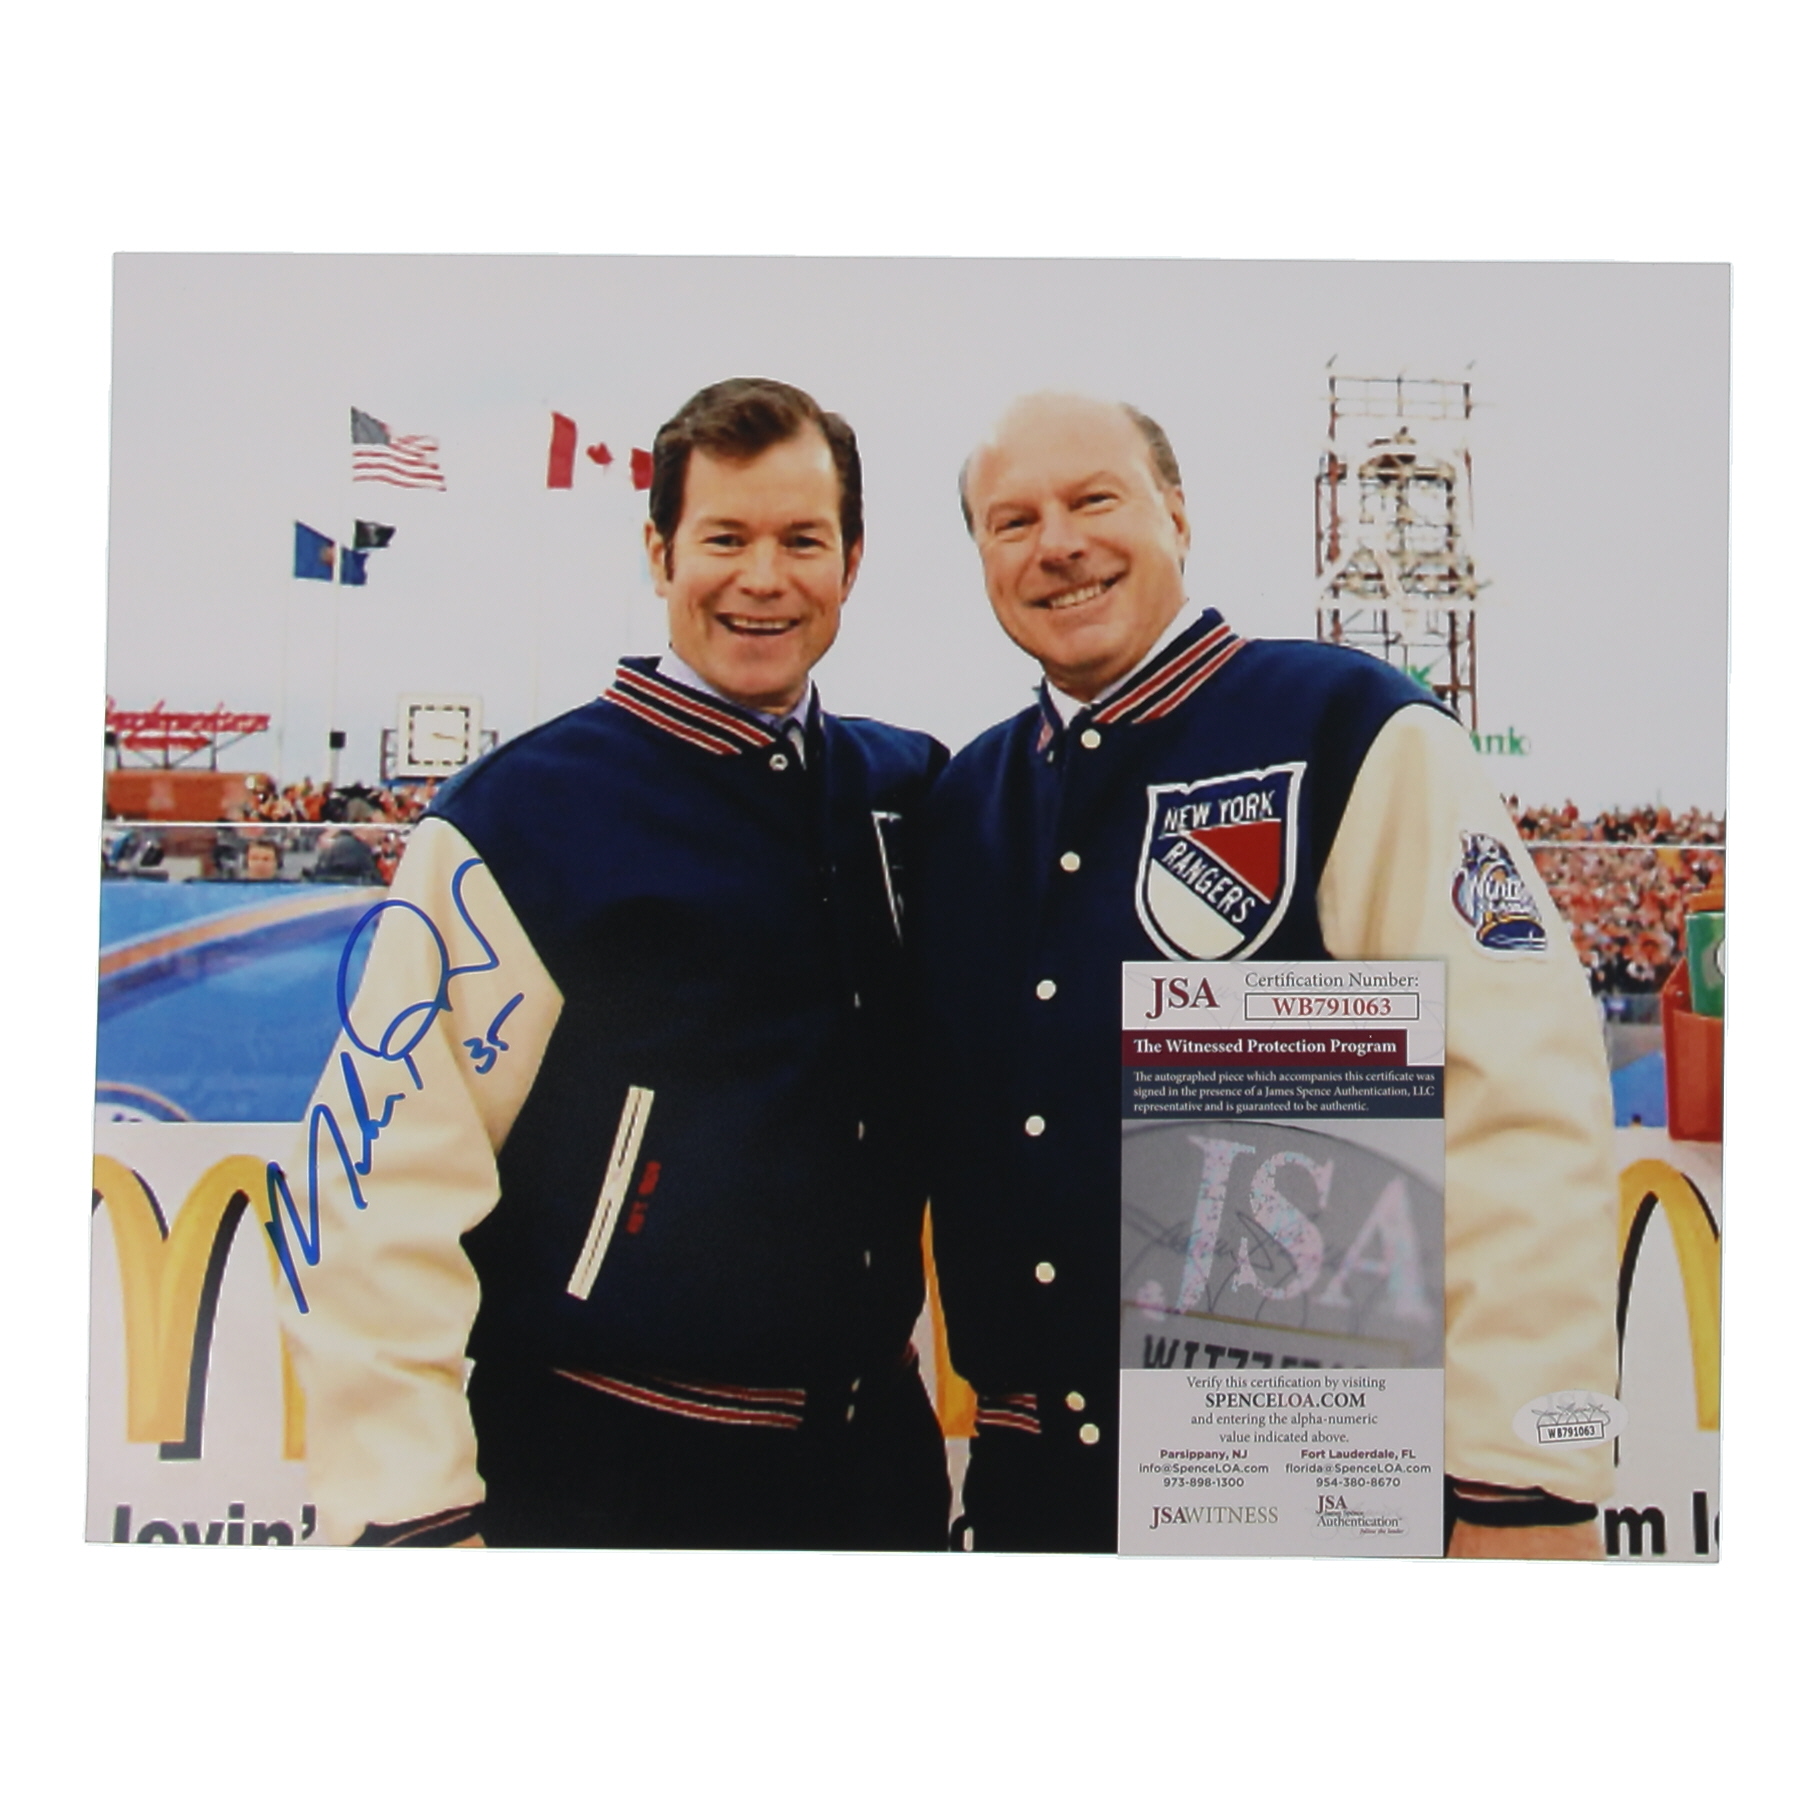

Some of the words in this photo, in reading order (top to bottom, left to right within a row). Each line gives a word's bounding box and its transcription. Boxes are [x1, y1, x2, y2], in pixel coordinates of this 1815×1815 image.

[1164, 801, 1213, 831] NEW
[1218, 789, 1276, 824] YORK
[1161, 840, 1256, 924] RANGERS
[1244, 972, 1344, 988] Certification
[1348, 972, 1419, 988] Number:
[1145, 977, 1221, 1020] JSA
[1271, 996, 1392, 1017] WB791063
[1133, 1038, 1162, 1054] The
[1165, 1038, 1243, 1053] Witnessed
[1247, 1038, 1326, 1053] Protection
[1330, 1039, 1397, 1057] Program
[1133, 1070, 1153, 1082] The
[1154, 1070, 1217, 1084] autographed
[1218, 1071, 1245, 1084] piece
[1246, 1070, 1277, 1082] which
[1278, 1072, 1343, 1084] accompanies
[1344, 1070, 1364, 1082] this
[1365, 1070, 1415, 1082] certificate
[1416, 1073, 1436, 1082] was
[1133, 1085, 1166, 1098] signed
[1168, 1086, 1179, 1097] in
[1180, 1085, 1196, 1097] the
[1199, 1088, 1242, 1099] presence
[1244, 1085, 1255, 1097] of
[1257, 1088, 1263, 1097] a
[1264, 1085, 1295, 1098] James
[1296, 1086, 1332, 1099] Spence
[1334, 1085, 1411, 1098] Authentication,
[1412, 1085, 1435, 1096] LLC
[1133, 1101, 1203, 1114] representative
[1204, 1100, 1224, 1112] and
[1225, 1101, 1235, 1112] is
[1236, 1101, 1291, 1114] guaranteed
[1293, 1102, 1304, 1111] to
[1305, 1100, 1319, 1111] be
[1320, 1100, 1369, 1112] authentic.
[1186, 1376, 1223, 1391] Verify
[1225, 1375, 1248, 1388] this
[1250, 1375, 1322, 1388] certification
[1324, 1375, 1340, 1391] by
[1341, 1376, 1386, 1391] visiting
[1205, 1392, 1366, 1408] SPENCELOA.COM
[1190, 1411, 1214, 1425] and
[1216, 1413, 1266, 1428] entering
[1268, 1411, 1288, 1425] the
[1290, 1411, 1378, 1428] alpha-numeric
[1219, 1430, 1251, 1443] value
[1253, 1430, 1308, 1443] indicated
[1311, 1430, 1349, 1443] above.
[1547, 1425, 1596, 1439] WB791063
[1160, 1449, 1230, 1461] Parsippany,
[1231, 1449, 1248, 1460] NJ
[1300, 1449, 1326, 1460] Fort
[1328, 1449, 1399, 1461] Lauderdale,
[1401, 1449, 1417, 1460] FL
[1139, 1462, 1269, 1475] info@SpenceLOA.com
[1285, 1462, 1432, 1475] florida@SpenceLOA.com
[1163, 1476, 1245, 1488] 973-898-1300
[1315, 1476, 1401, 1488] 954-380-8670
[1315, 1495, 1347, 1514] JSA
[1316, 1515, 1399, 1527] Authentication
